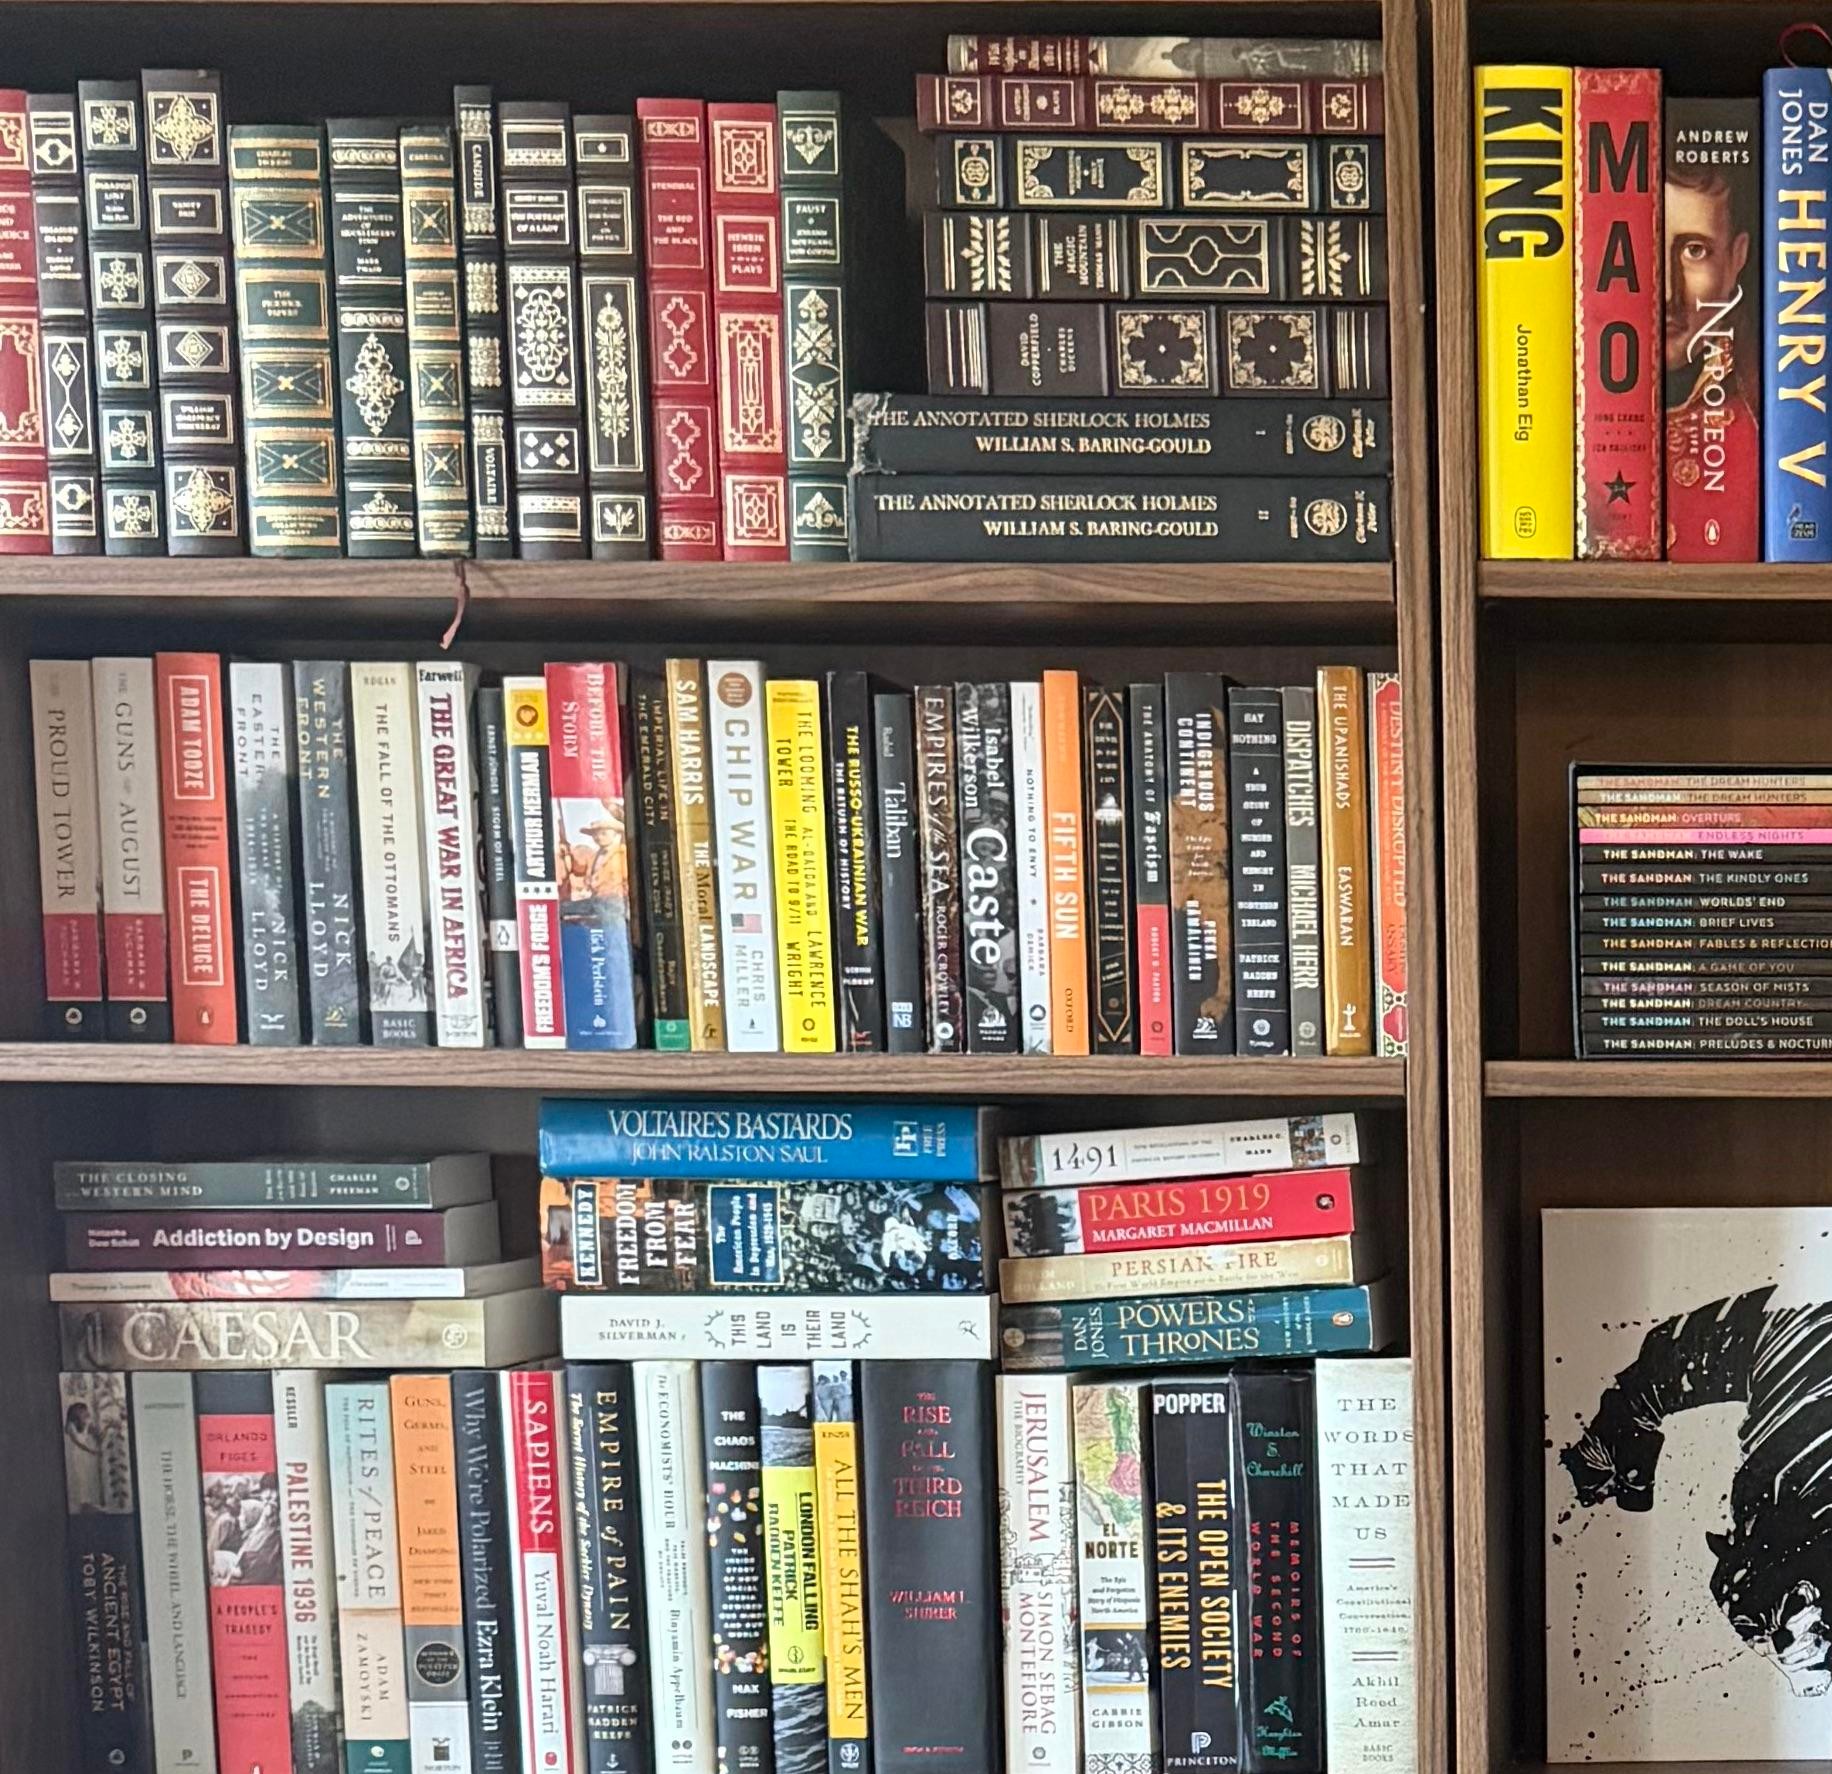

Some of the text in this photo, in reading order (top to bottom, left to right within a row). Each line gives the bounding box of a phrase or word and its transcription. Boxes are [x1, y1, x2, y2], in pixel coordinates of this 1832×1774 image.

[1676, 130, 1749, 143] ANDREW
[1676, 151, 1750, 164] ROBERTS
[1482, 87, 1564, 260] KING
[1778, 190, 1827, 486] HENRY V
[875, 494, 1218, 511] THE ANNOTATED SHERLOCK HOLMES
[722, 721, 760, 901] CHIP WAR
[430, 693, 468, 999] THE GREAT WAR IN AFRICA
[1603, 851, 1628, 859] THE
[1701, 851, 1724, 859] THE
[1728, 851, 1763, 860] WAKE
[1050, 812, 1080, 942] FIFTH SUN
[966, 828, 1008, 967] Caste
[1760, 898, 1785, 907] END
[1701, 1040, 1763, 1049] PRELUDES
[734, 1112, 851, 1141] BASTARDS
[1090, 1183, 1271, 1221] PARIS 1919
[153, 1228, 374, 1250] Addiction by Design
[1119, 1300, 1245, 1330] POWERS
[123, 1310, 372, 1361] CAESAR
[1120, 1327, 1260, 1356] THRONES
[1153, 1394, 1225, 1415] POPPER
[525, 1398, 553, 1536] SAPIENS
[1103, 1524, 1120, 1537] EL
[1085, 1541, 1138, 1559] NORTE
[1195, 1479, 1234, 1690] THE OPEN SOCIETY
[534, 1568, 557, 1738] Yuval Noah Harari
[1167, 1757, 1237, 1767] PRINCETON
